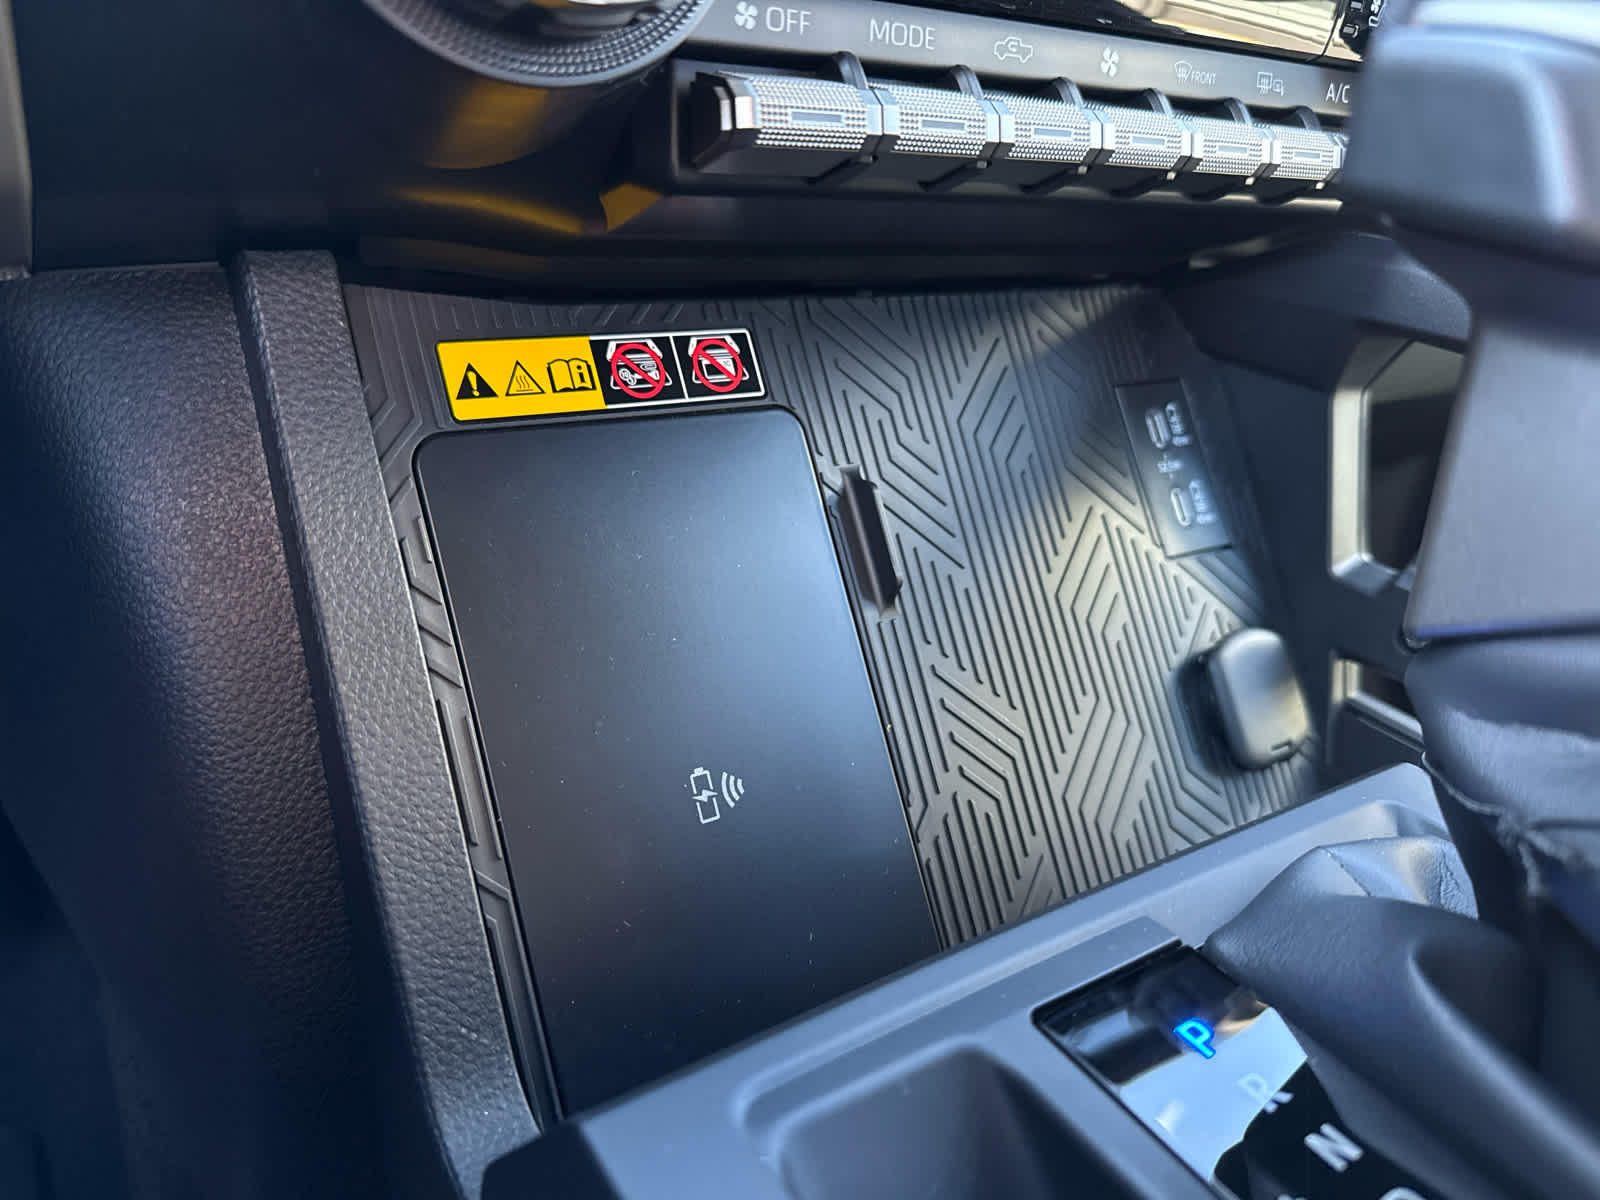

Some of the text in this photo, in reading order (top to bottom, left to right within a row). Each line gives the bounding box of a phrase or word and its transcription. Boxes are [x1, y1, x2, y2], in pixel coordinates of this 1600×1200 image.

[765, 7, 811, 35] OFF
[869, 18, 936, 50] MODE
[1191, 71, 1216, 86] FRONT
[1326, 82, 1350, 104] A/C
[1173, 1017, 1216, 1060] P
[1236, 1072, 1295, 1114] R
[1304, 1122, 1363, 1173] N
